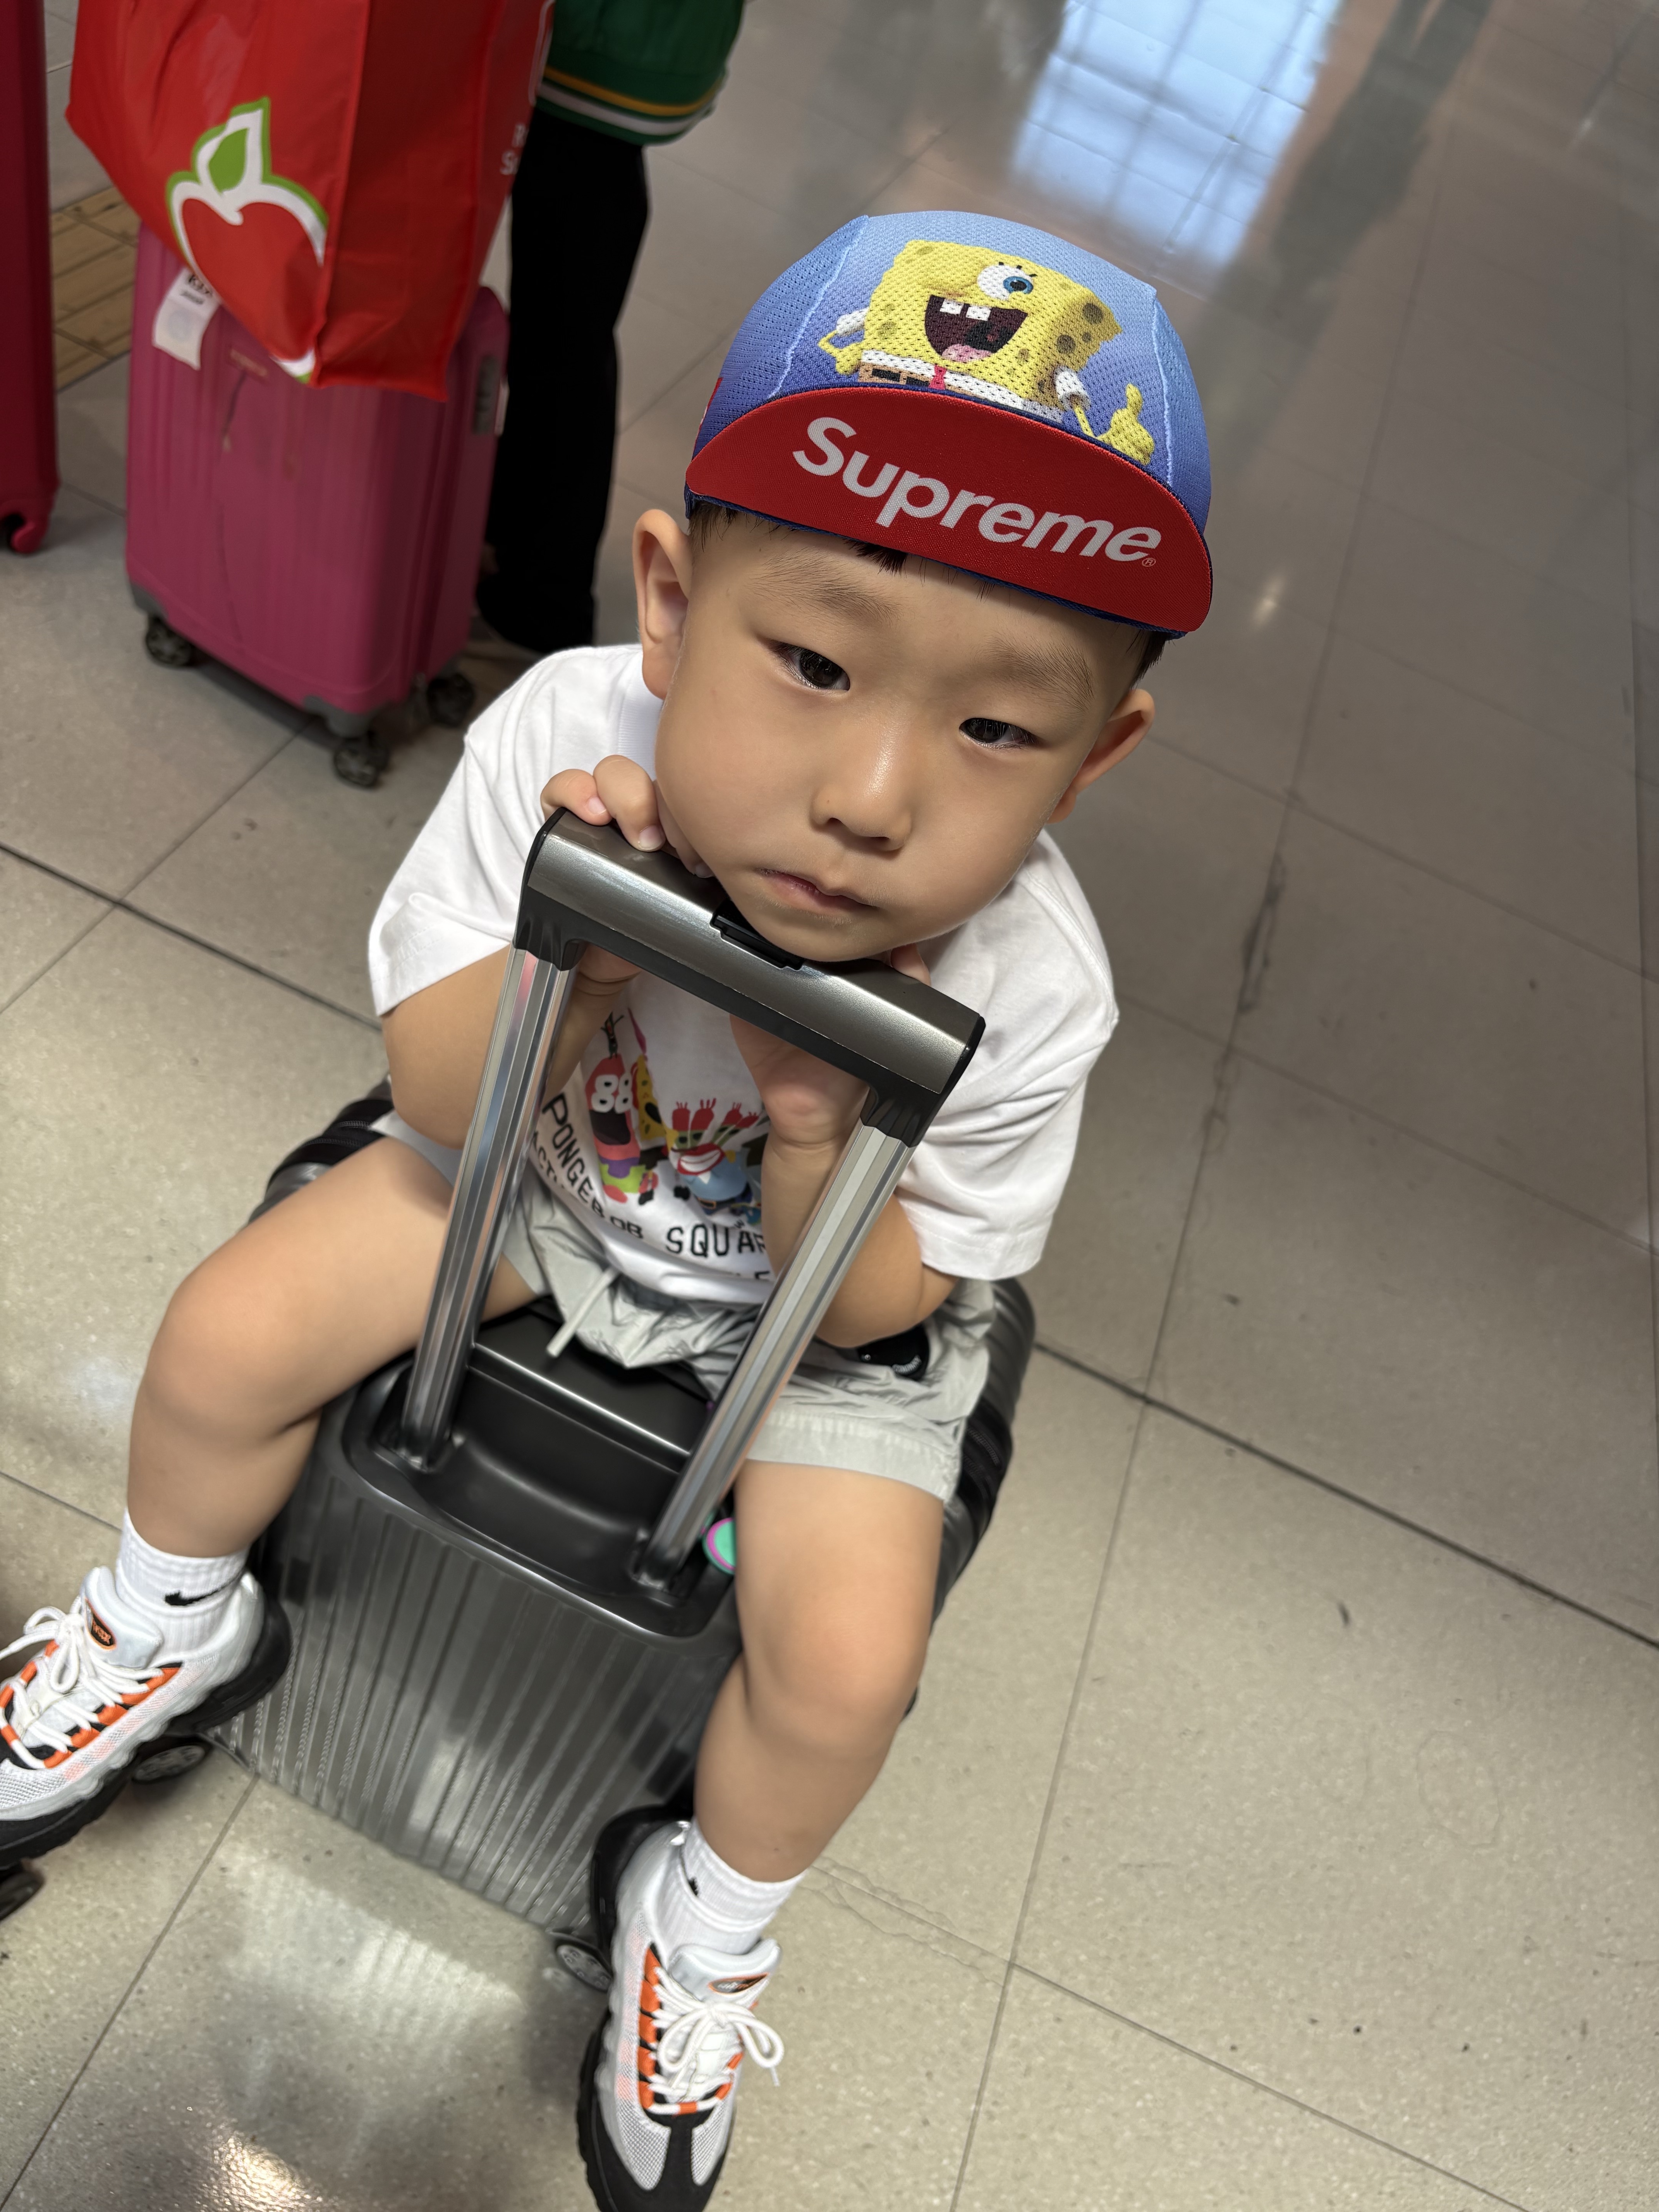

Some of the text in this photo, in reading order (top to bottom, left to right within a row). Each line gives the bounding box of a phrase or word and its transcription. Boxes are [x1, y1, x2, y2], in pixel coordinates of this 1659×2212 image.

[792, 417, 1161, 562] Supreme
[543, 1093, 644, 1239] PONGEBOB
[666, 1223, 766, 1257] SQUAR
